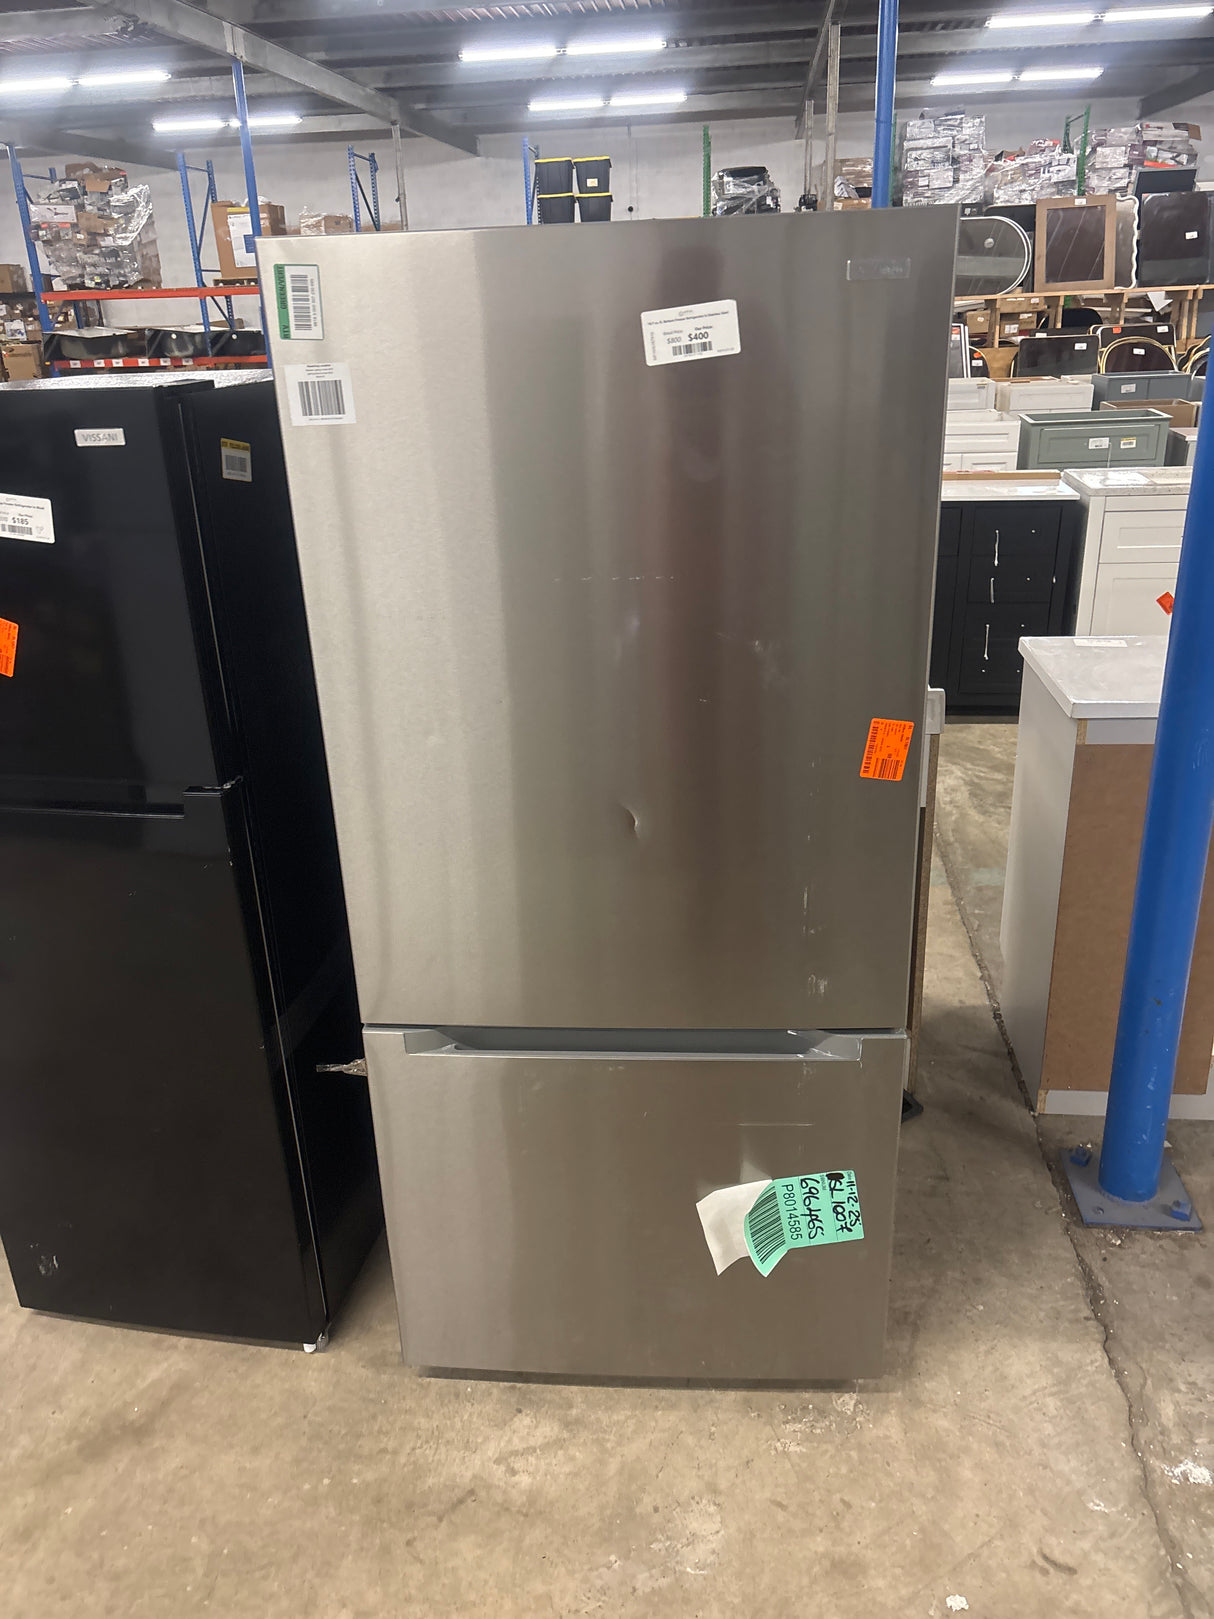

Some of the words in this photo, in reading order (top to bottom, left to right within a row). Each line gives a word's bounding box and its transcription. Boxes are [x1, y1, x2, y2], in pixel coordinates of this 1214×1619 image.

[277, 265, 288, 310] GREEN/VERT
[667, 336, 682, 345] $800
[687, 331, 709, 342] $400
[81, 432, 119, 442] VISSANI
[12, 517, 29, 525] $185
[781, 1183, 803, 1241] P8014585
